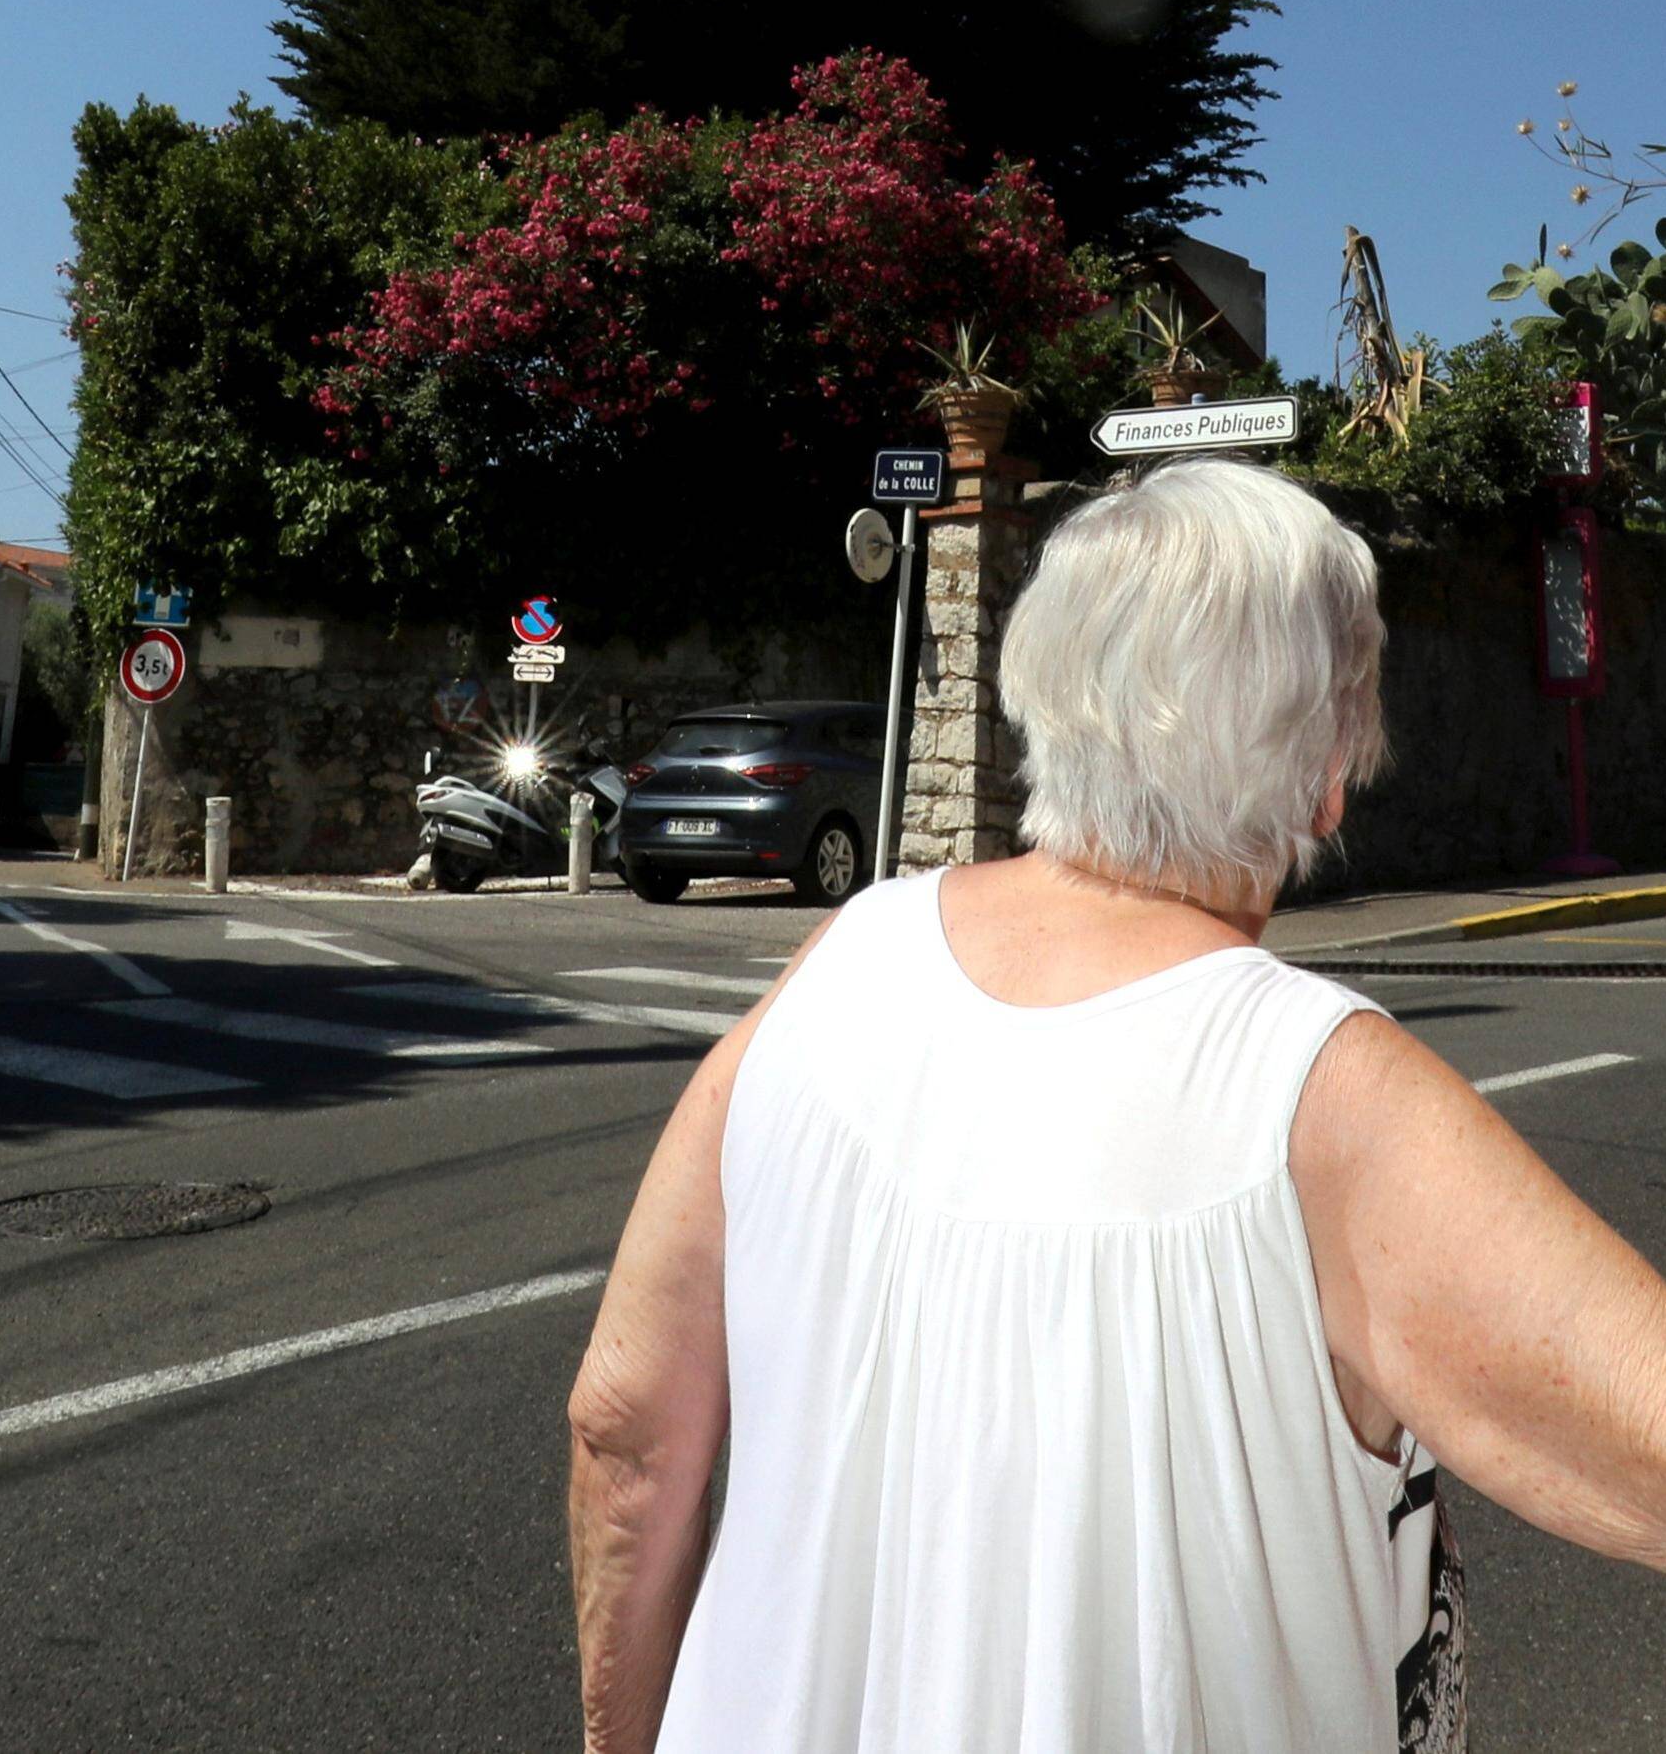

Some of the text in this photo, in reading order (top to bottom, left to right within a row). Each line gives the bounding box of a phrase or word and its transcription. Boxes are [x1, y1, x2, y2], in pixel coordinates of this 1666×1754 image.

[1114, 413, 1286, 442] Finances Publiques
[893, 459, 924, 471] CHEMIN
[878, 477, 935, 491] de la COLLE
[134, 655, 168, 676] 3,5t
